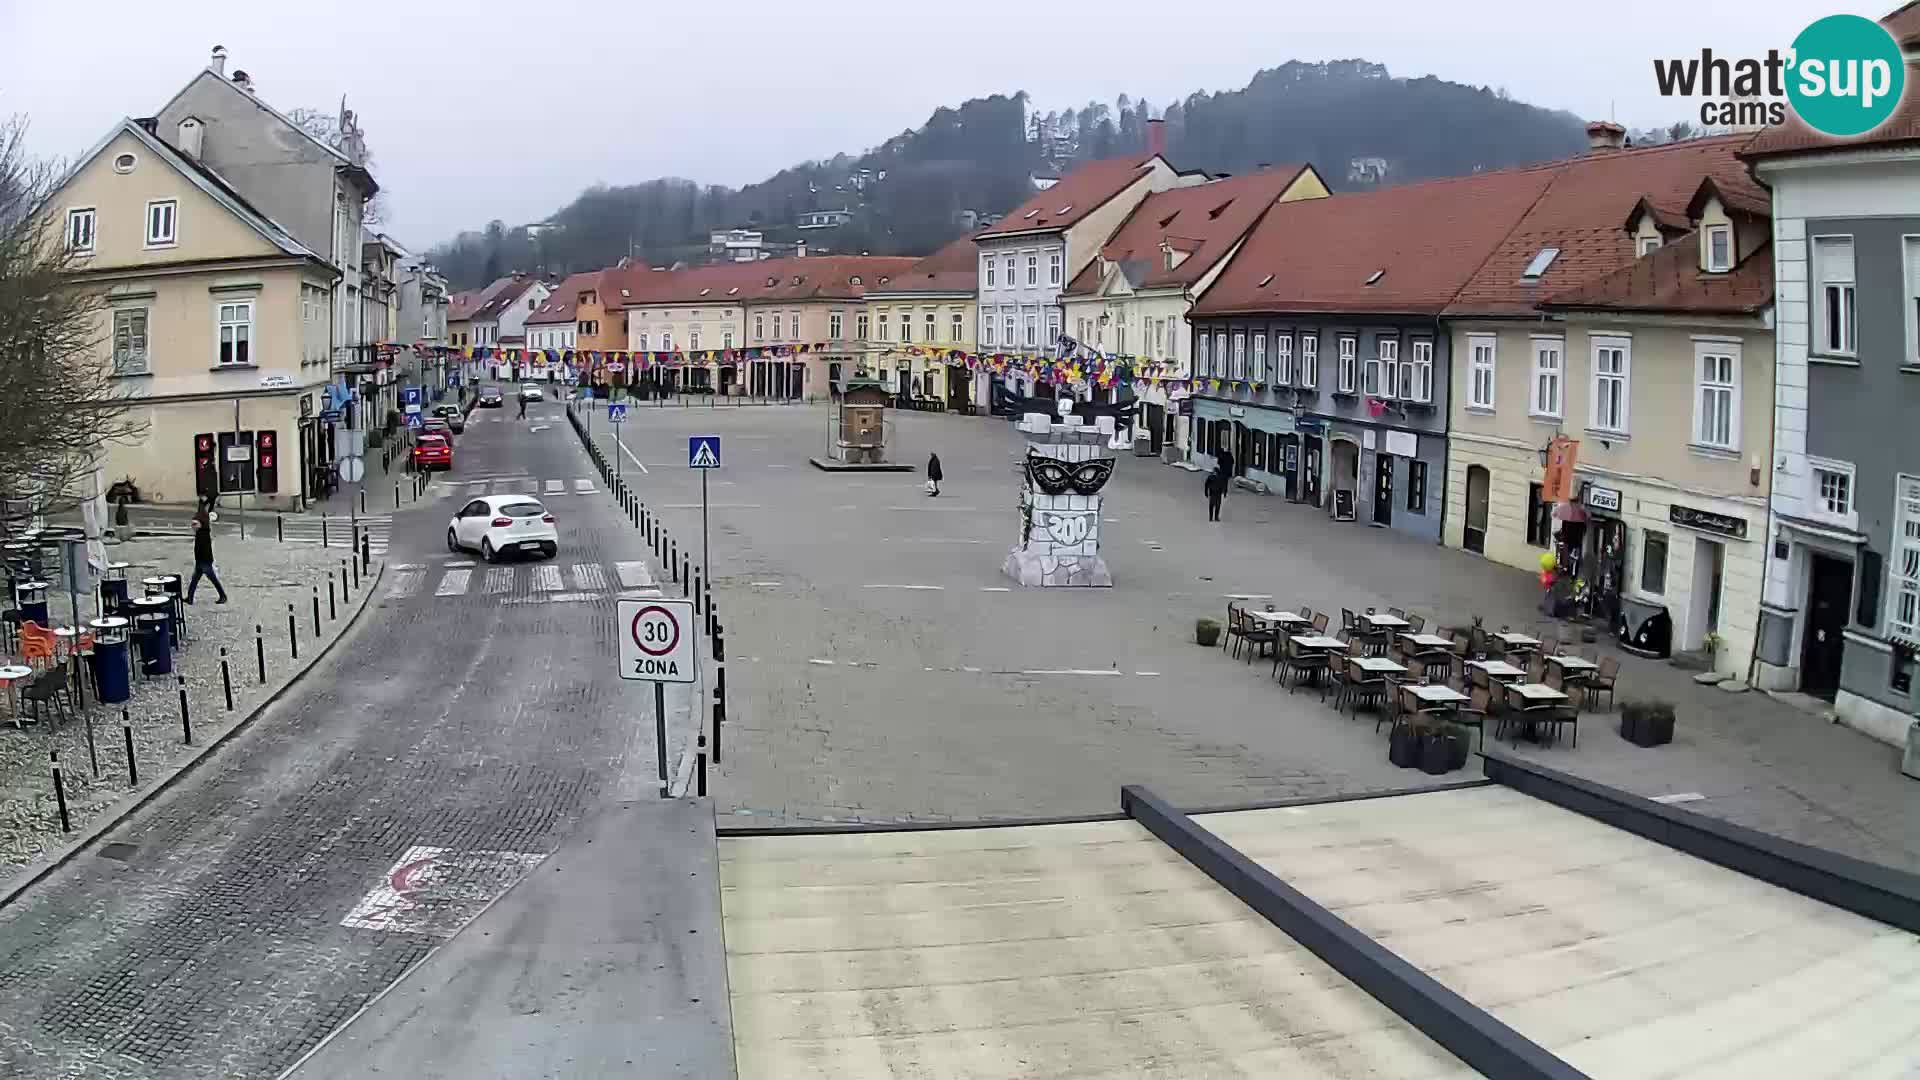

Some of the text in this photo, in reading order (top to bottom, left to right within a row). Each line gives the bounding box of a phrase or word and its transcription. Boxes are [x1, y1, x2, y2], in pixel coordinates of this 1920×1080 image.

[409, 391, 417, 402] P
[1048, 516, 1087, 545] 200
[644, 621, 668, 642] 30
[634, 658, 679, 676] ZONA
